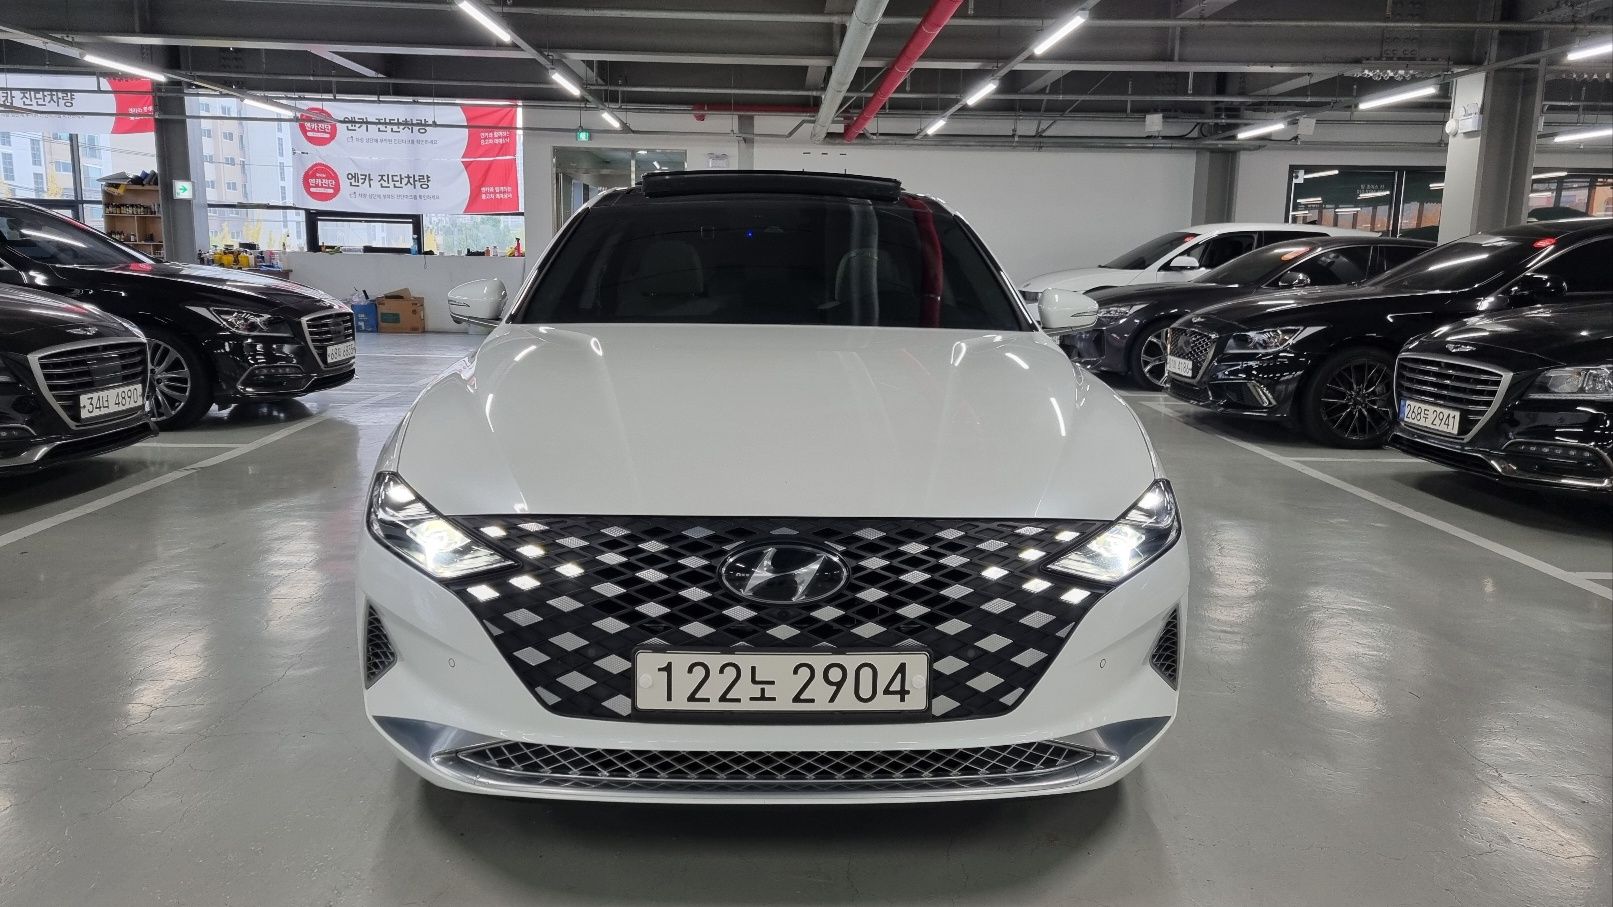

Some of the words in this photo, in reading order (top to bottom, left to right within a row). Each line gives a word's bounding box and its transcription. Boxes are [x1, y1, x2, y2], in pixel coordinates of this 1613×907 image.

[20, 91, 75, 108] 진단차량
[343, 116, 369, 133] 엔카
[375, 117, 429, 135] 진단차량
[308, 178, 336, 188] 엔카진단
[346, 172, 373, 188] 엔카
[378, 173, 431, 190] 진단차량
[86, 394, 110, 414] 34너
[114, 387, 139, 407] 4890
[1405, 403, 1430, 423] 268두
[1431, 409, 1456, 431] 2941
[657, 661, 777, 703] 122노
[791, 661, 911, 703] 2904
